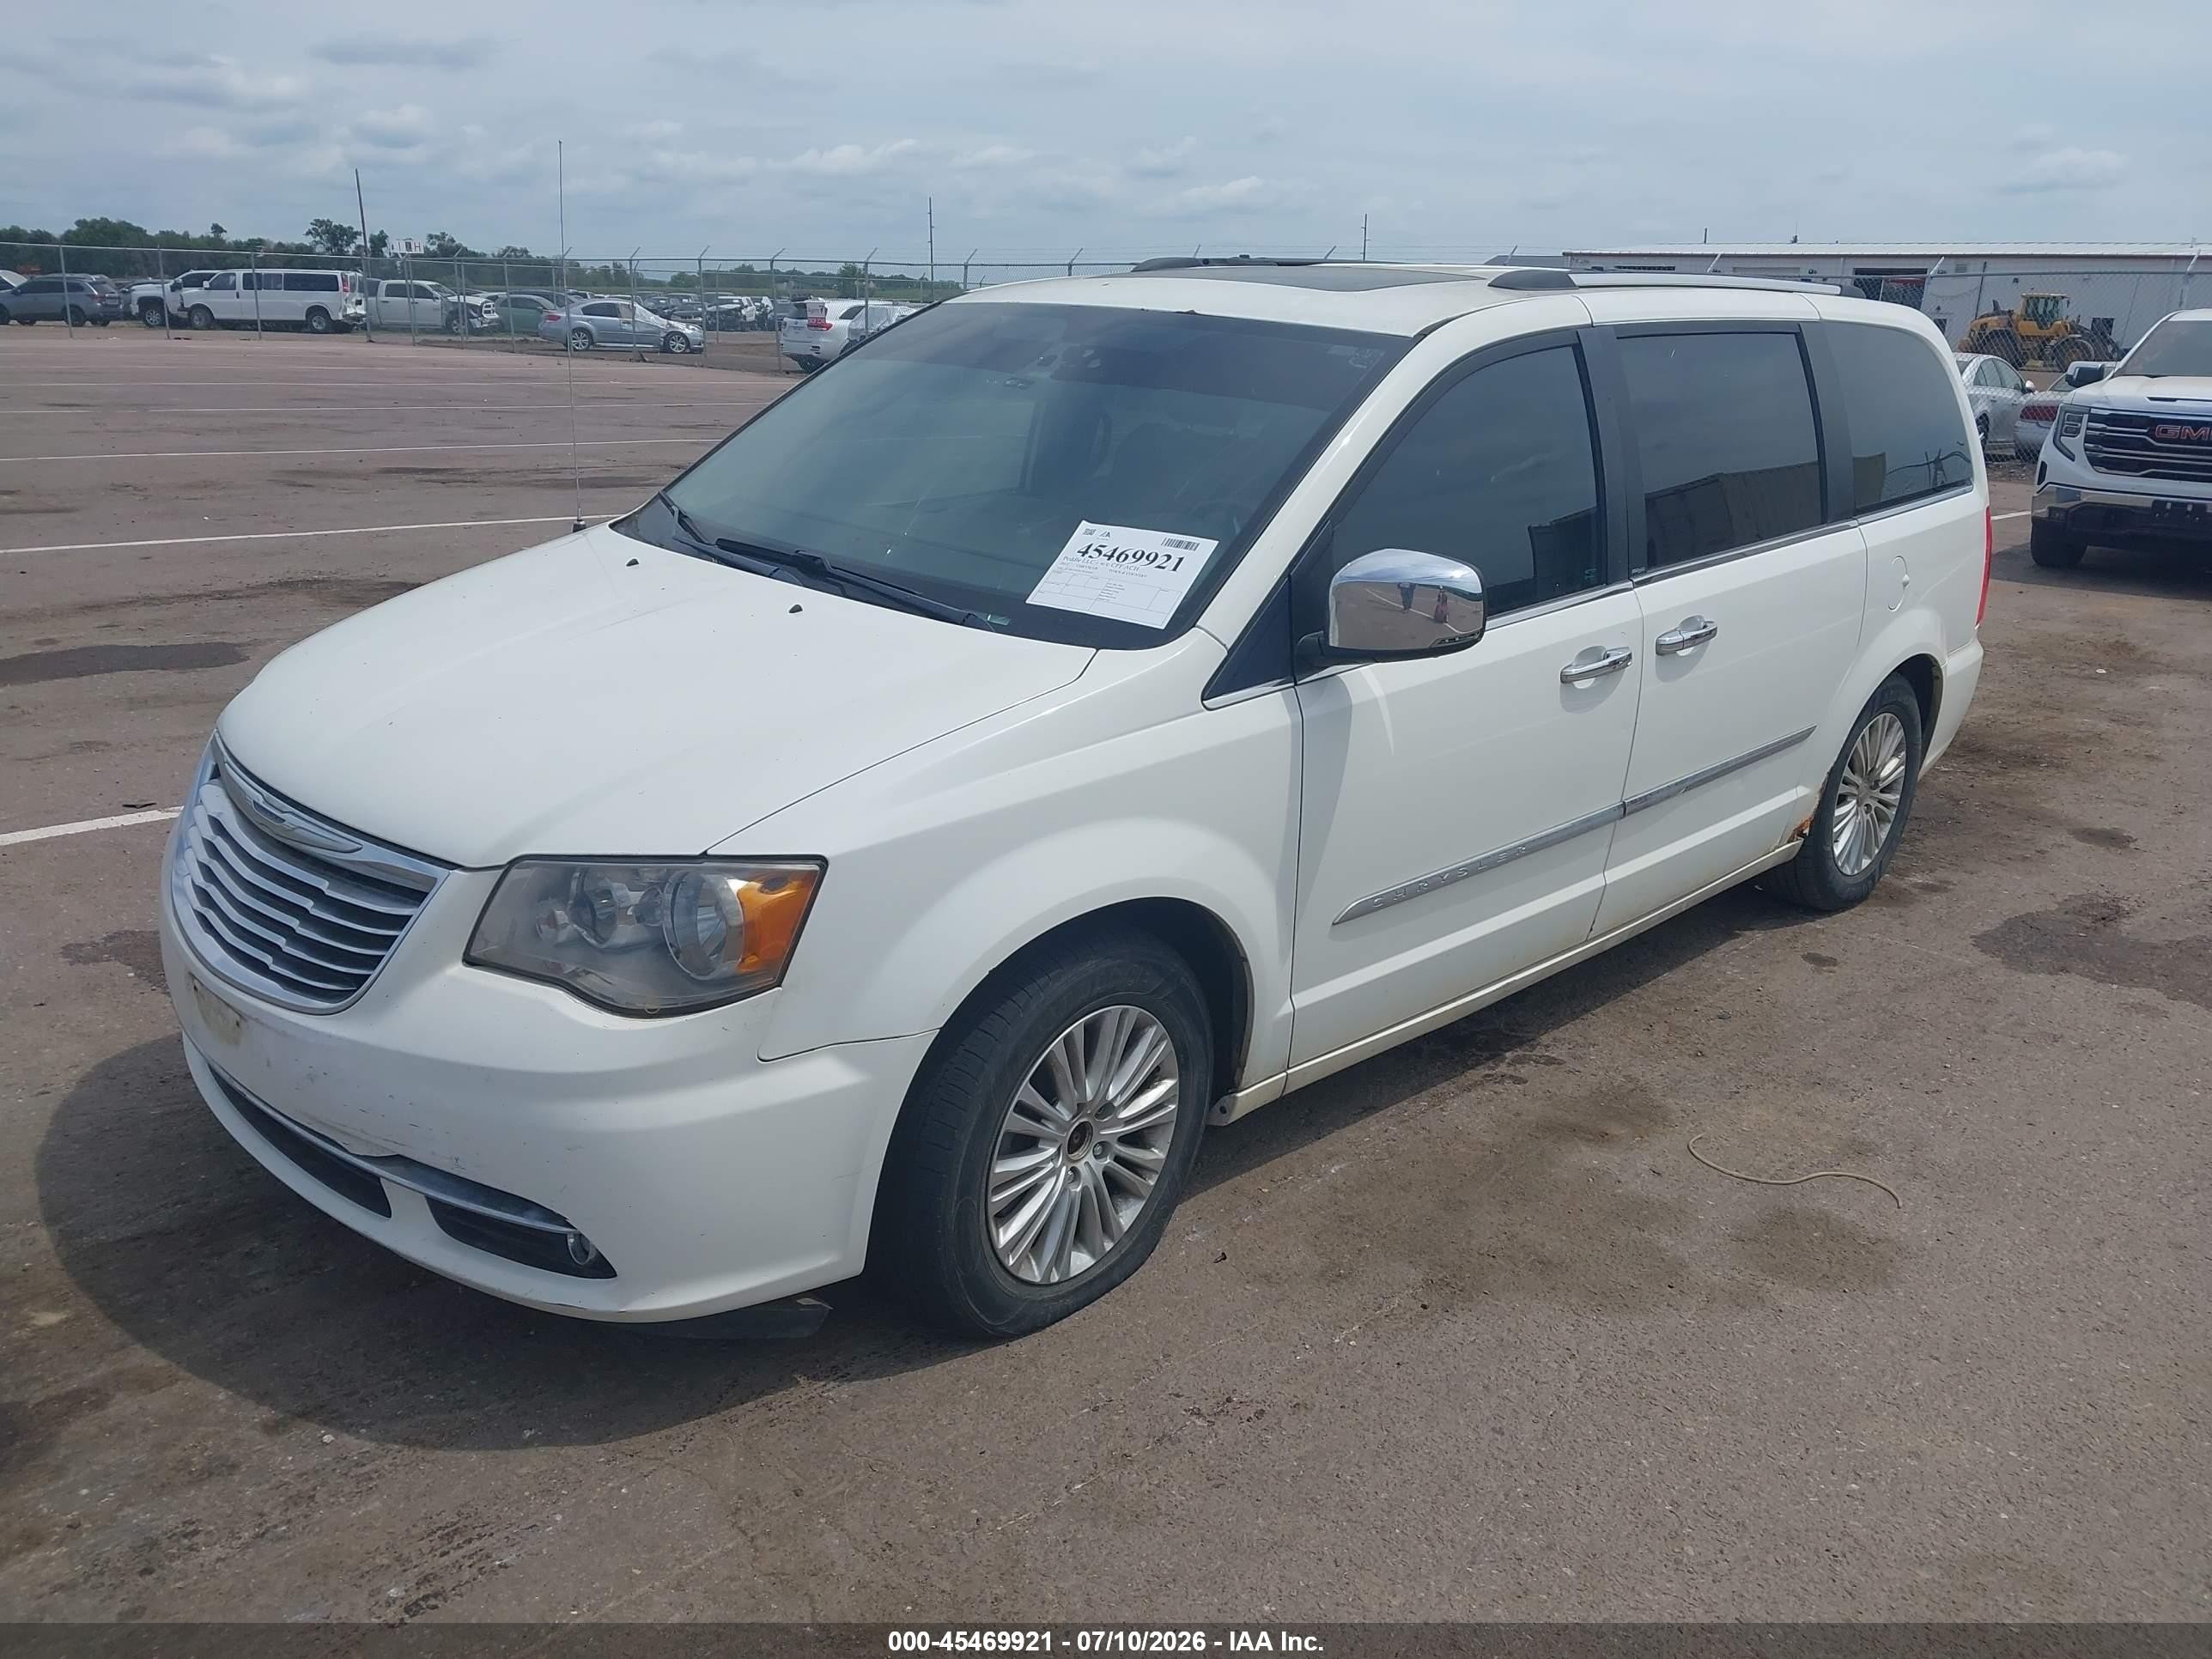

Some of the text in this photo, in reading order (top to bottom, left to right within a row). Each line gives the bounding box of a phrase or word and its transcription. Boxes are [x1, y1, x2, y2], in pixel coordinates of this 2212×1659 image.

[2155, 424, 2212, 441] GM
[1077, 543, 1186, 572] 45469921
[1374, 845, 1526, 908] CHRYSLER
